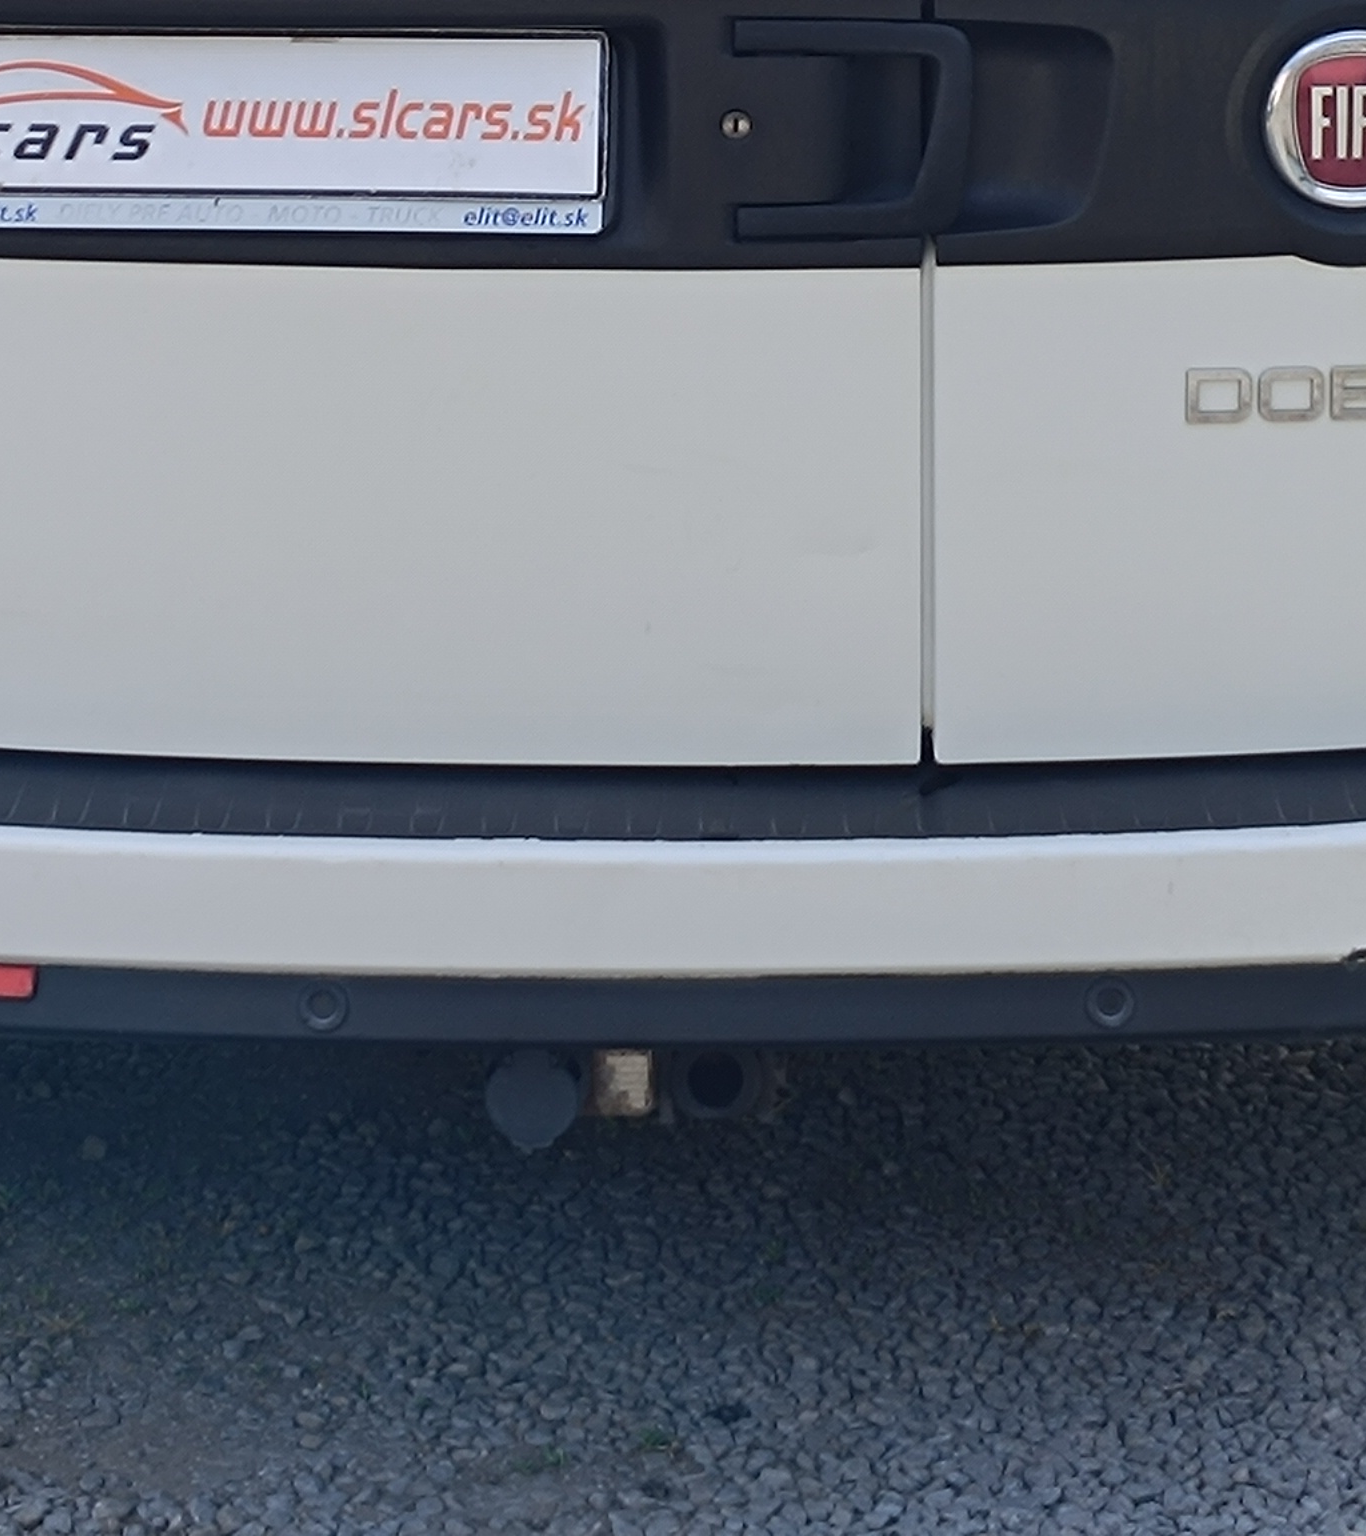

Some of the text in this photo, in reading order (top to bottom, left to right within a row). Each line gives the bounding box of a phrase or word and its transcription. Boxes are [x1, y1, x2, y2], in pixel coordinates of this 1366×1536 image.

[202, 88, 587, 142] www.slcars.sk
[266, 204, 342, 224] MOTO
[463, 205, 590, 227] elit@elit.sk
